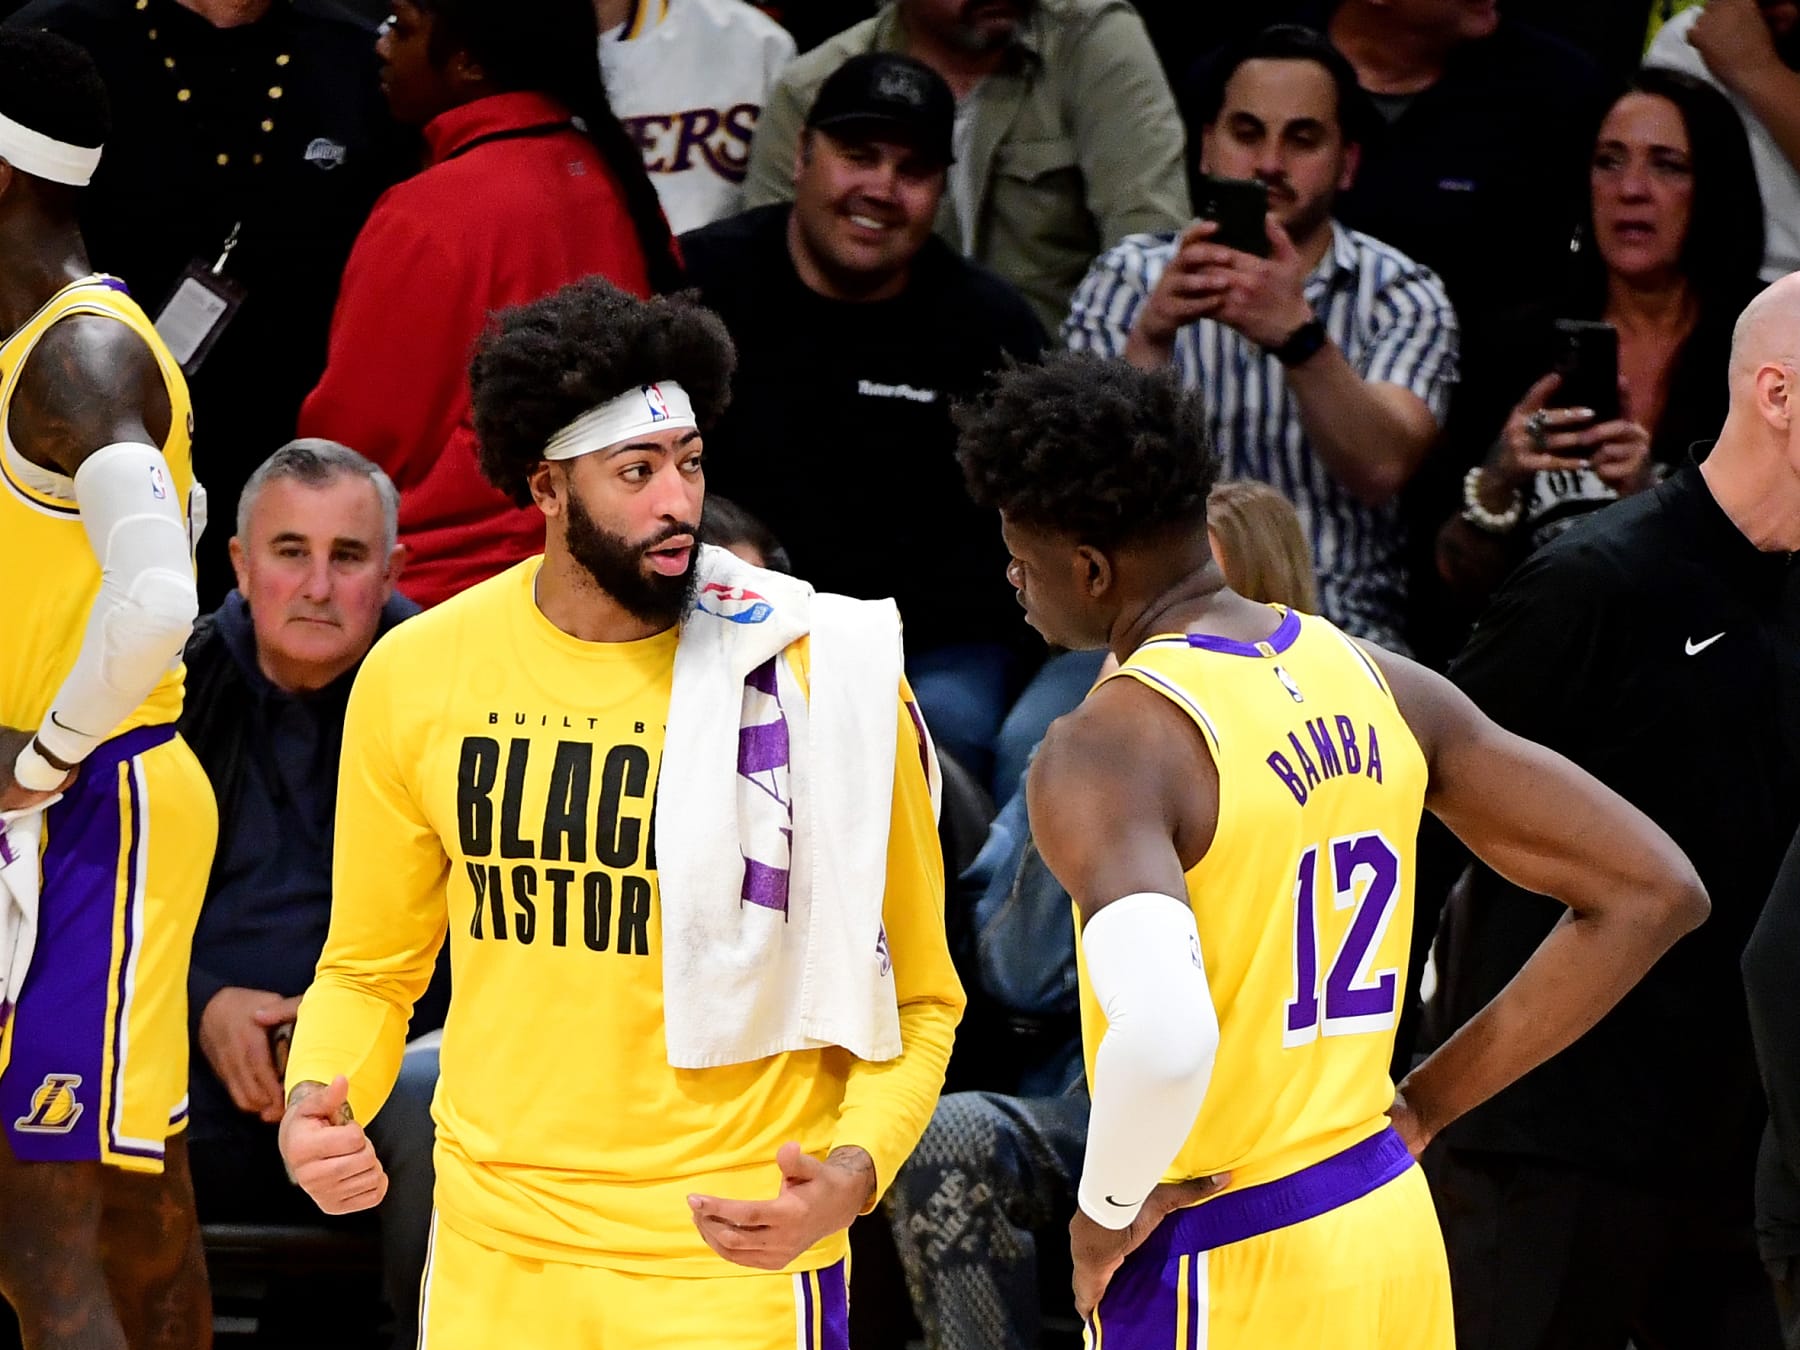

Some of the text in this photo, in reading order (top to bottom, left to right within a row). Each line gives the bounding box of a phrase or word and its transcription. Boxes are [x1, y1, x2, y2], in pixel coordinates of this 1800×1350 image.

[488, 711, 599, 731] BUILT
[1266, 714, 1384, 808] BAMBA
[456, 736, 660, 871] BLAC
[465, 860, 662, 957] HISTOR
[1282, 829, 1402, 1050] 12
